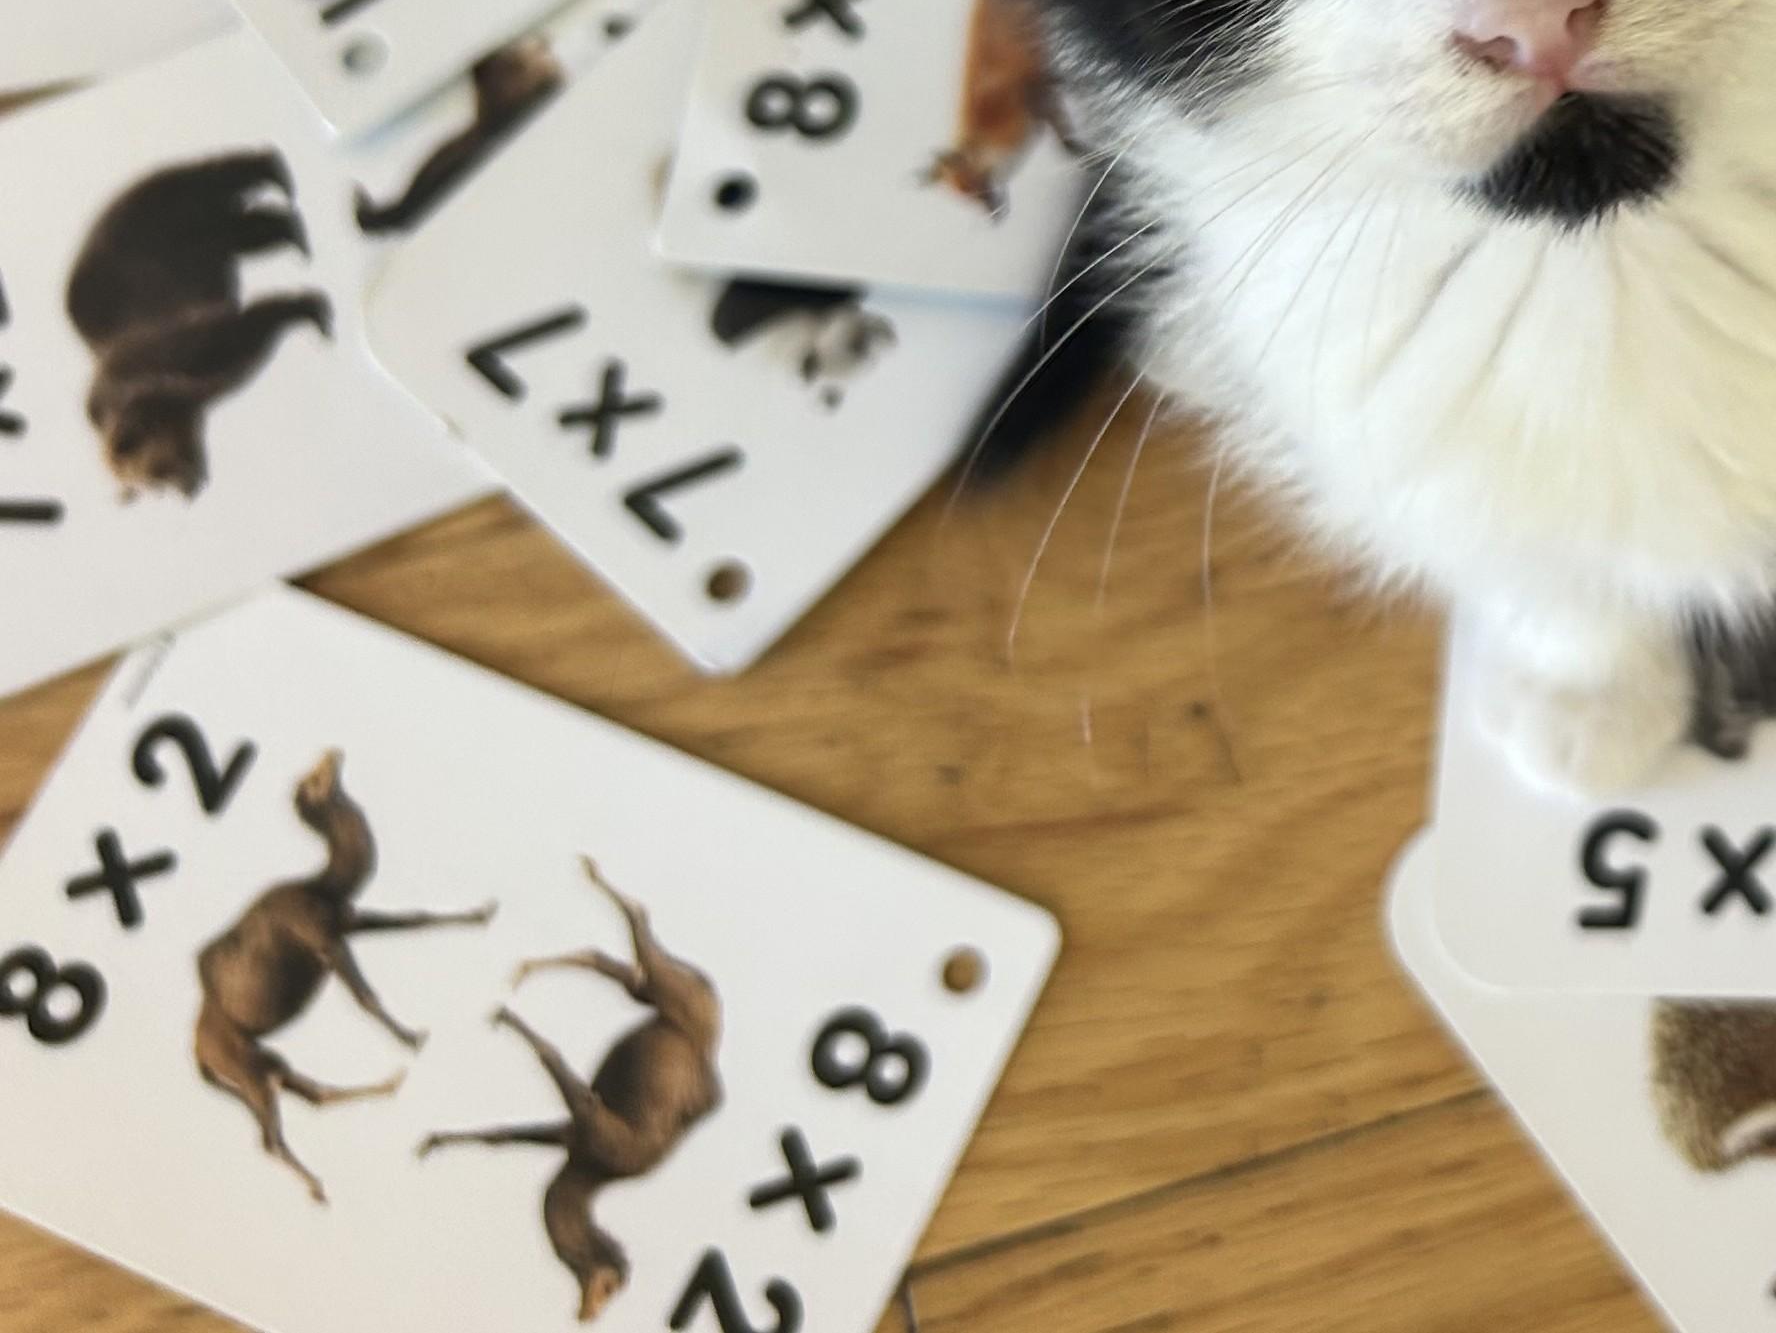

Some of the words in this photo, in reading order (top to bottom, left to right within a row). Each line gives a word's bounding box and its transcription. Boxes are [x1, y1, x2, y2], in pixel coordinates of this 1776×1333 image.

[742, 74, 858, 143] 8
[464, 307, 585, 401] 7
[557, 361, 661, 459] x
[621, 449, 742, 544] 7
[0, 946, 106, 1048] 8
[65, 830, 176, 931] x
[130, 715, 255, 816] 2
[1577, 811, 1658, 932] 5
[809, 1008, 928, 1108] 8
[748, 1128, 860, 1234] x
[668, 1249, 802, 1333] 2
